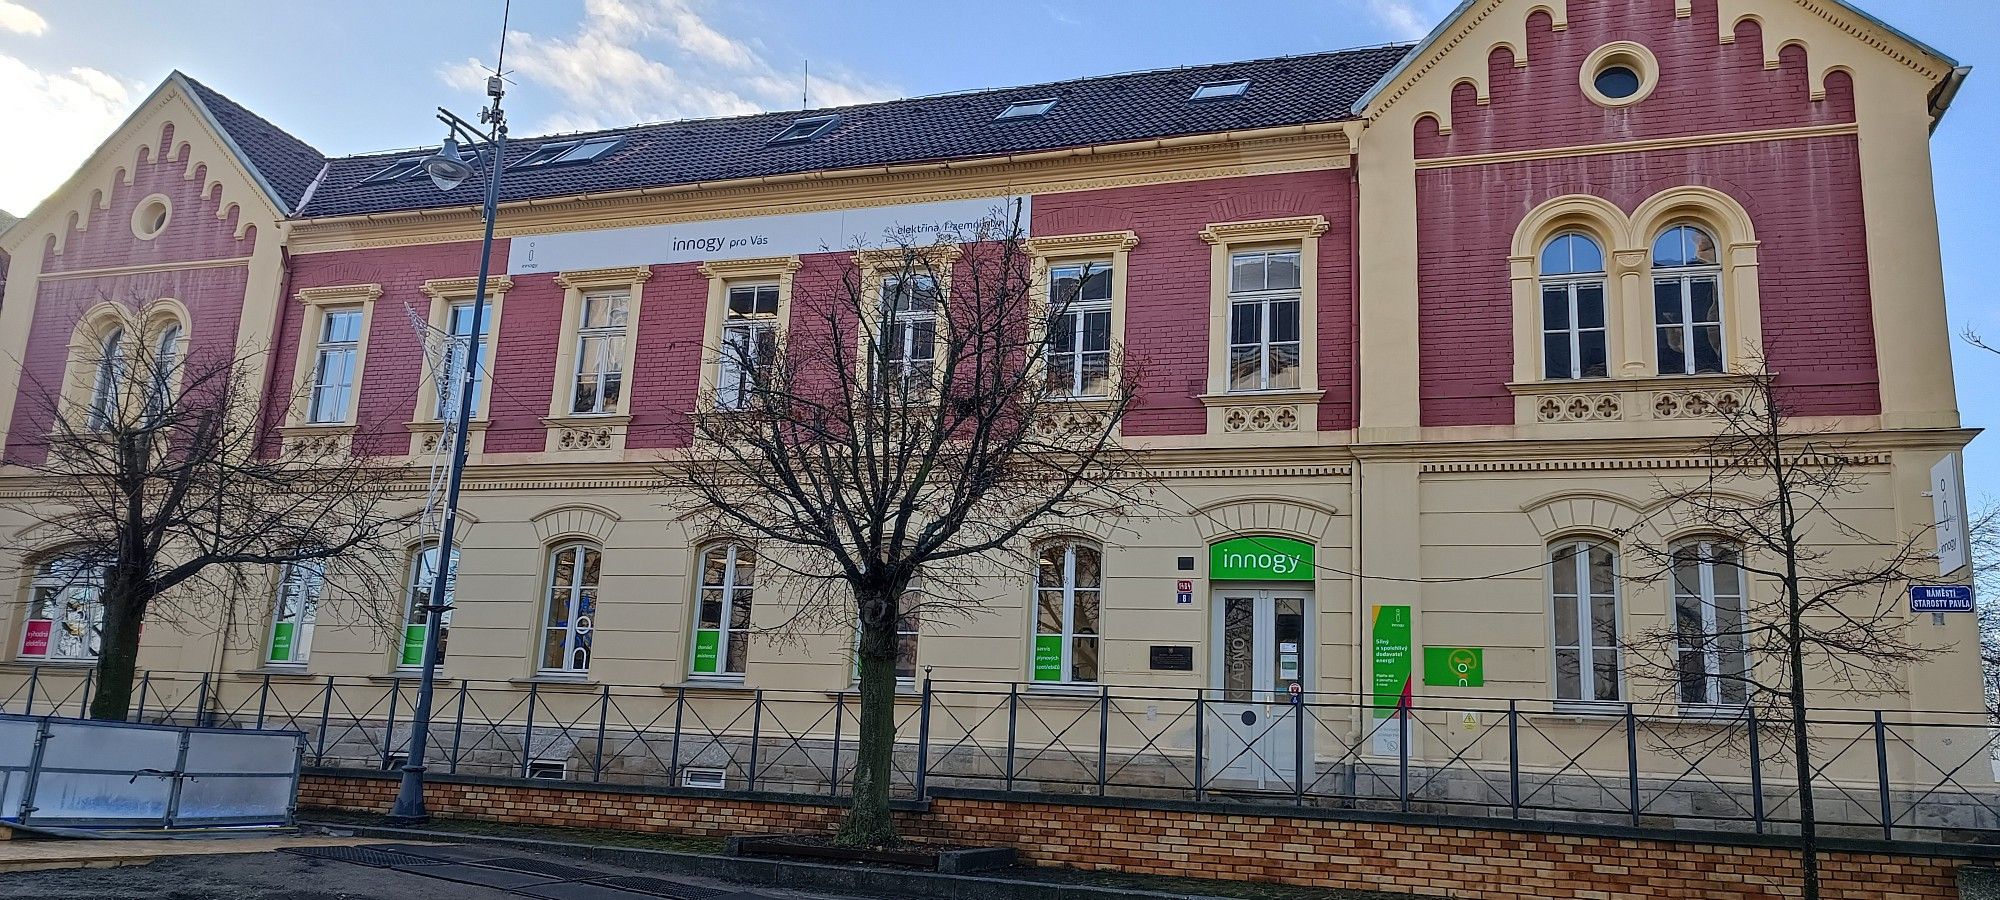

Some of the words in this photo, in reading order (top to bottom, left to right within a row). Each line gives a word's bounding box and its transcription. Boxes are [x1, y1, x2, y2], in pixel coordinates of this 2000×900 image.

[673, 237, 725, 252] innogy
[729, 239, 747, 249] pro
[750, 235, 768, 246] Vás
[1223, 548, 1300, 573] innogy
[1926, 588, 1956, 597] NÁMĚSTÍ
